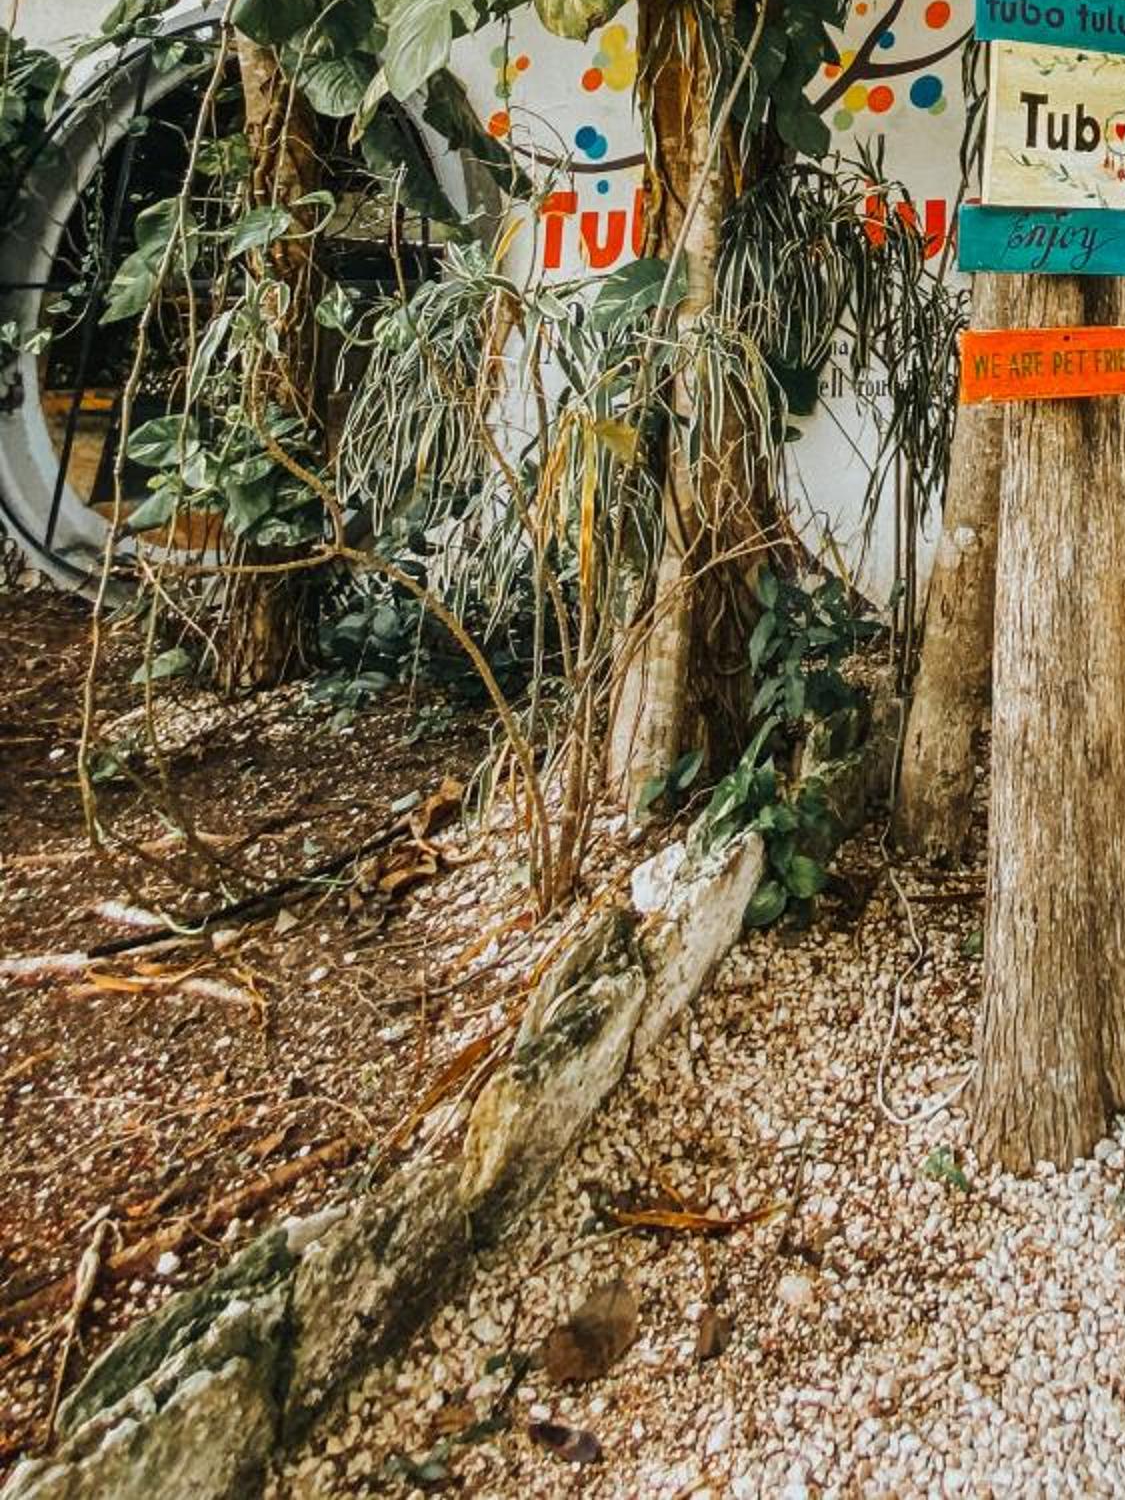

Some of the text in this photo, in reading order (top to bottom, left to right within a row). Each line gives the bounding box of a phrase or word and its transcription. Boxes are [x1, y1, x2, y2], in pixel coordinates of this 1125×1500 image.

[1004, 218, 1115, 271] Enjoy
[973, 353, 1002, 381] WE
[1008, 351, 1043, 377] ARE
[1052, 349, 1089, 376] PET
